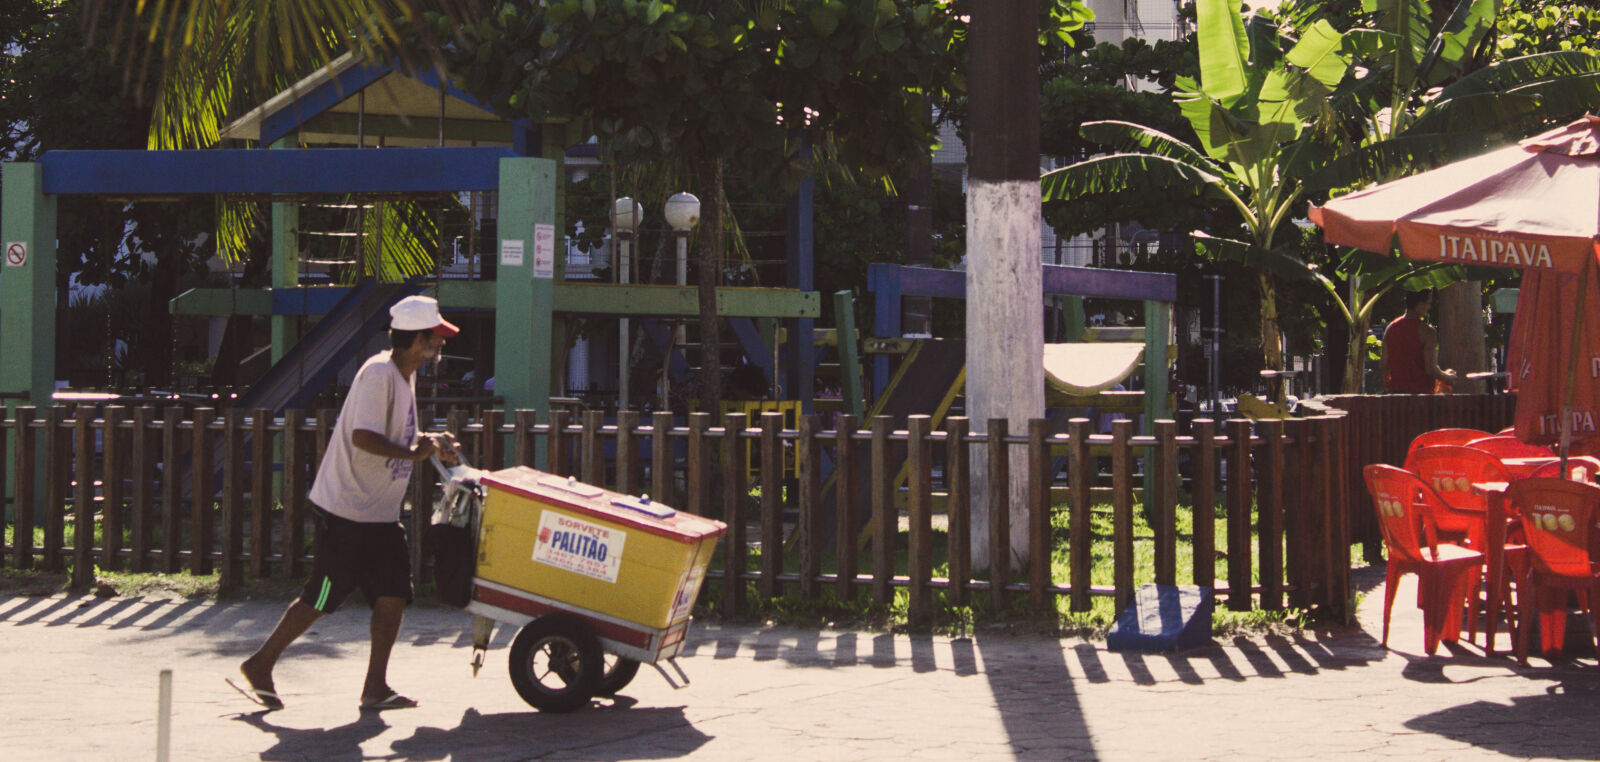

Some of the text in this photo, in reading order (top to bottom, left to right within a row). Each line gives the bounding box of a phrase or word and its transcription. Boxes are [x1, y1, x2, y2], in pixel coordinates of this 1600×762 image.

[1439, 234, 1553, 268] ITAIPAVA
[558, 517, 609, 539] SORVETE
[551, 530, 608, 562] PALITÃO
